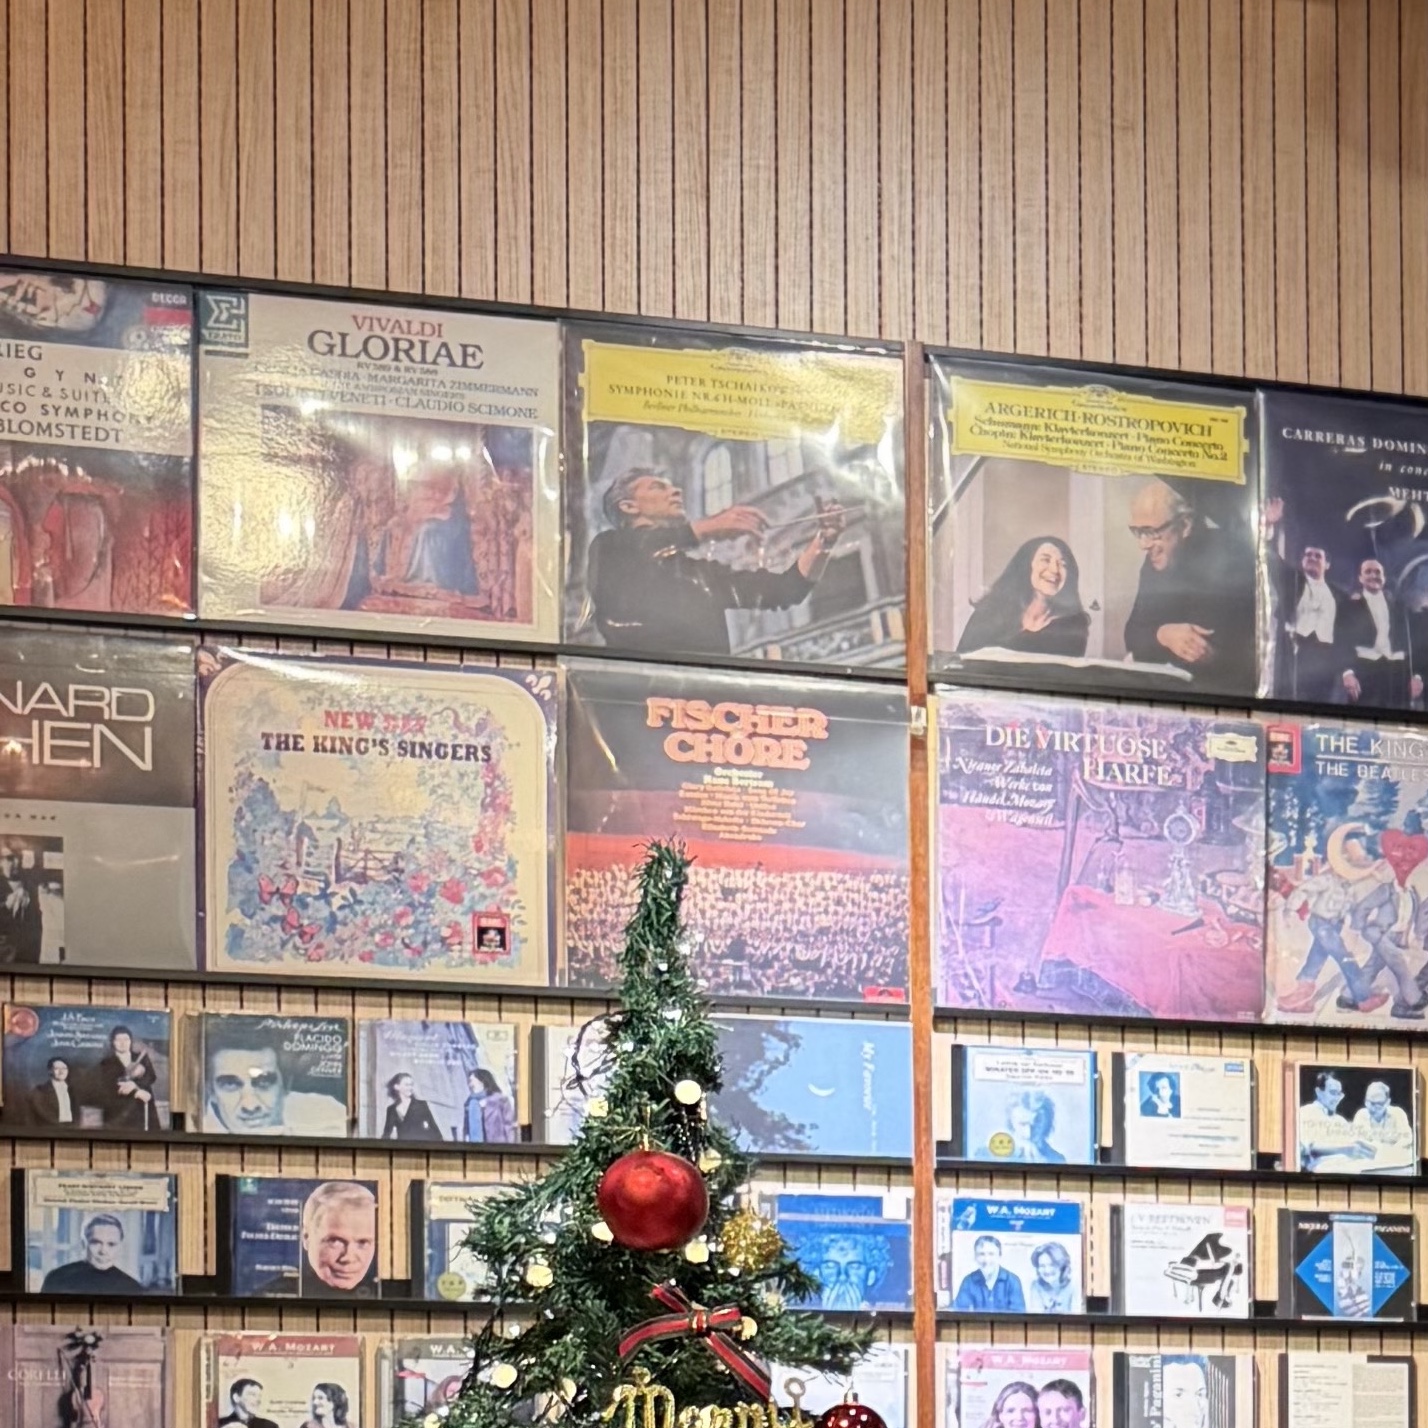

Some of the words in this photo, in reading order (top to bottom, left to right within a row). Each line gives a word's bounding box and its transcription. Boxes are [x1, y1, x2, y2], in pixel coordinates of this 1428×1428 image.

[352, 314, 442, 338] VIVALDI
[307, 329, 484, 370] GLORIAE
[367, 373, 447, 390] MARGARITA
[449, 380, 539, 399] ZIMMERMANN
[666, 375, 707, 387] PETER
[608, 384, 686, 399] SYMPHONIE
[395, 395, 464, 413] CLAUDIO
[467, 401, 539, 420] SCIMONE
[1112, 440, 1144, 452] Piano
[1136, 432, 1170, 445] Piano
[1173, 436, 1224, 451] Concerto
[1282, 427, 1366, 448] CARRERAS
[1379, 461, 1392, 472] in
[324, 710, 376, 730] NEW
[646, 696, 829, 739] FISCHER
[261, 732, 305, 752] THE
[313, 735, 390, 756] KING'S
[397, 739, 492, 763] SINGERS
[663, 728, 810, 770] CHÖRE
[986, 725, 1032, 749] DIE
[1036, 729, 1168, 760] VIRTUOSE
[1315, 733, 1359, 753] THE
[1084, 757, 1174, 786] HARFE
[1316, 761, 1349, 777] THE
[294, 1033, 342, 1044] PLACIDO
[1013, 1206, 1057, 1217] MOZART
[285, 1342, 336, 1355] MOZART
[1149, 1354, 1162, 1418] Paganini
